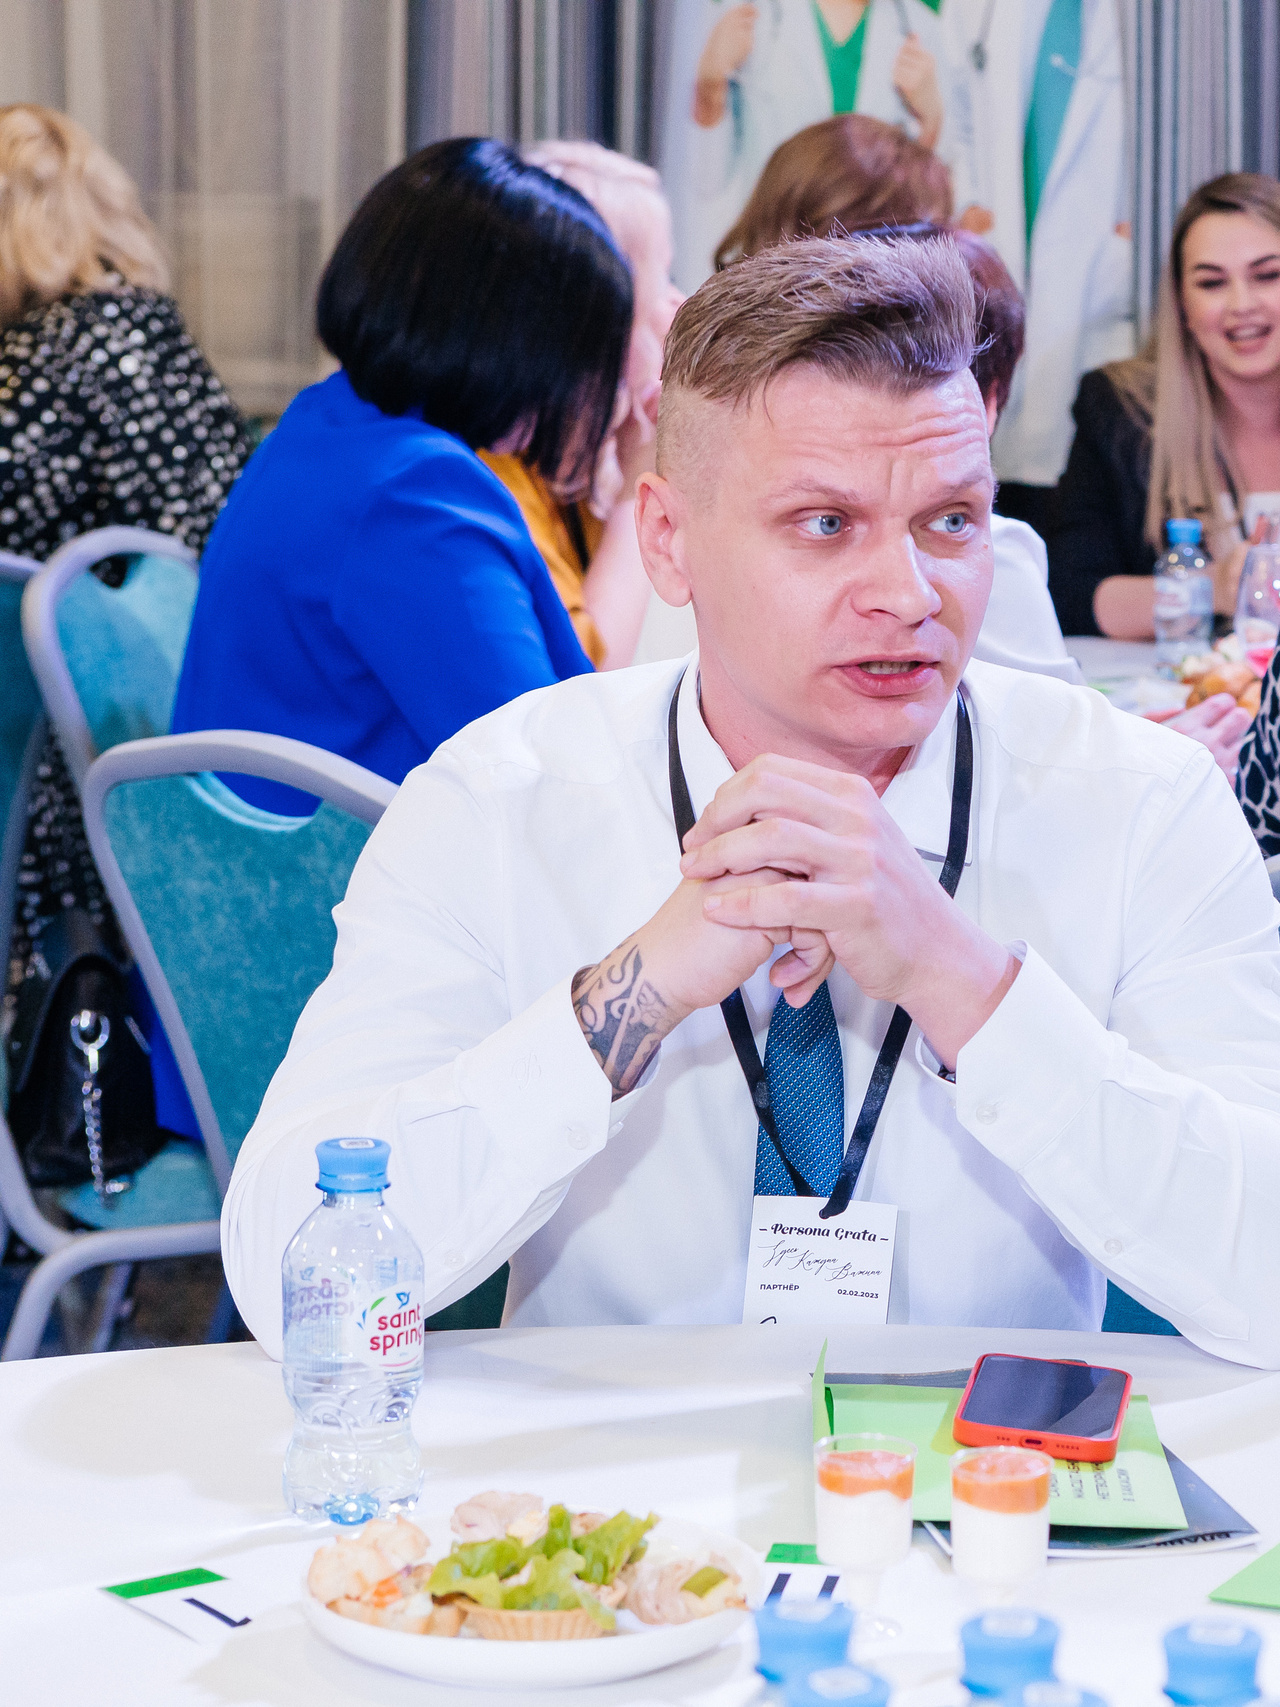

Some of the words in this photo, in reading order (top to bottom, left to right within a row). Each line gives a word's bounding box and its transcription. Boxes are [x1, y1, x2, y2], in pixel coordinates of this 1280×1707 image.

[771, 1223, 830, 1237] Persona
[835, 1228, 877, 1242] Grata
[760, 1283, 800, 1291] ПАРТНЁР
[837, 1288, 879, 1299] 02.02.2023
[378, 1303, 421, 1330] saint
